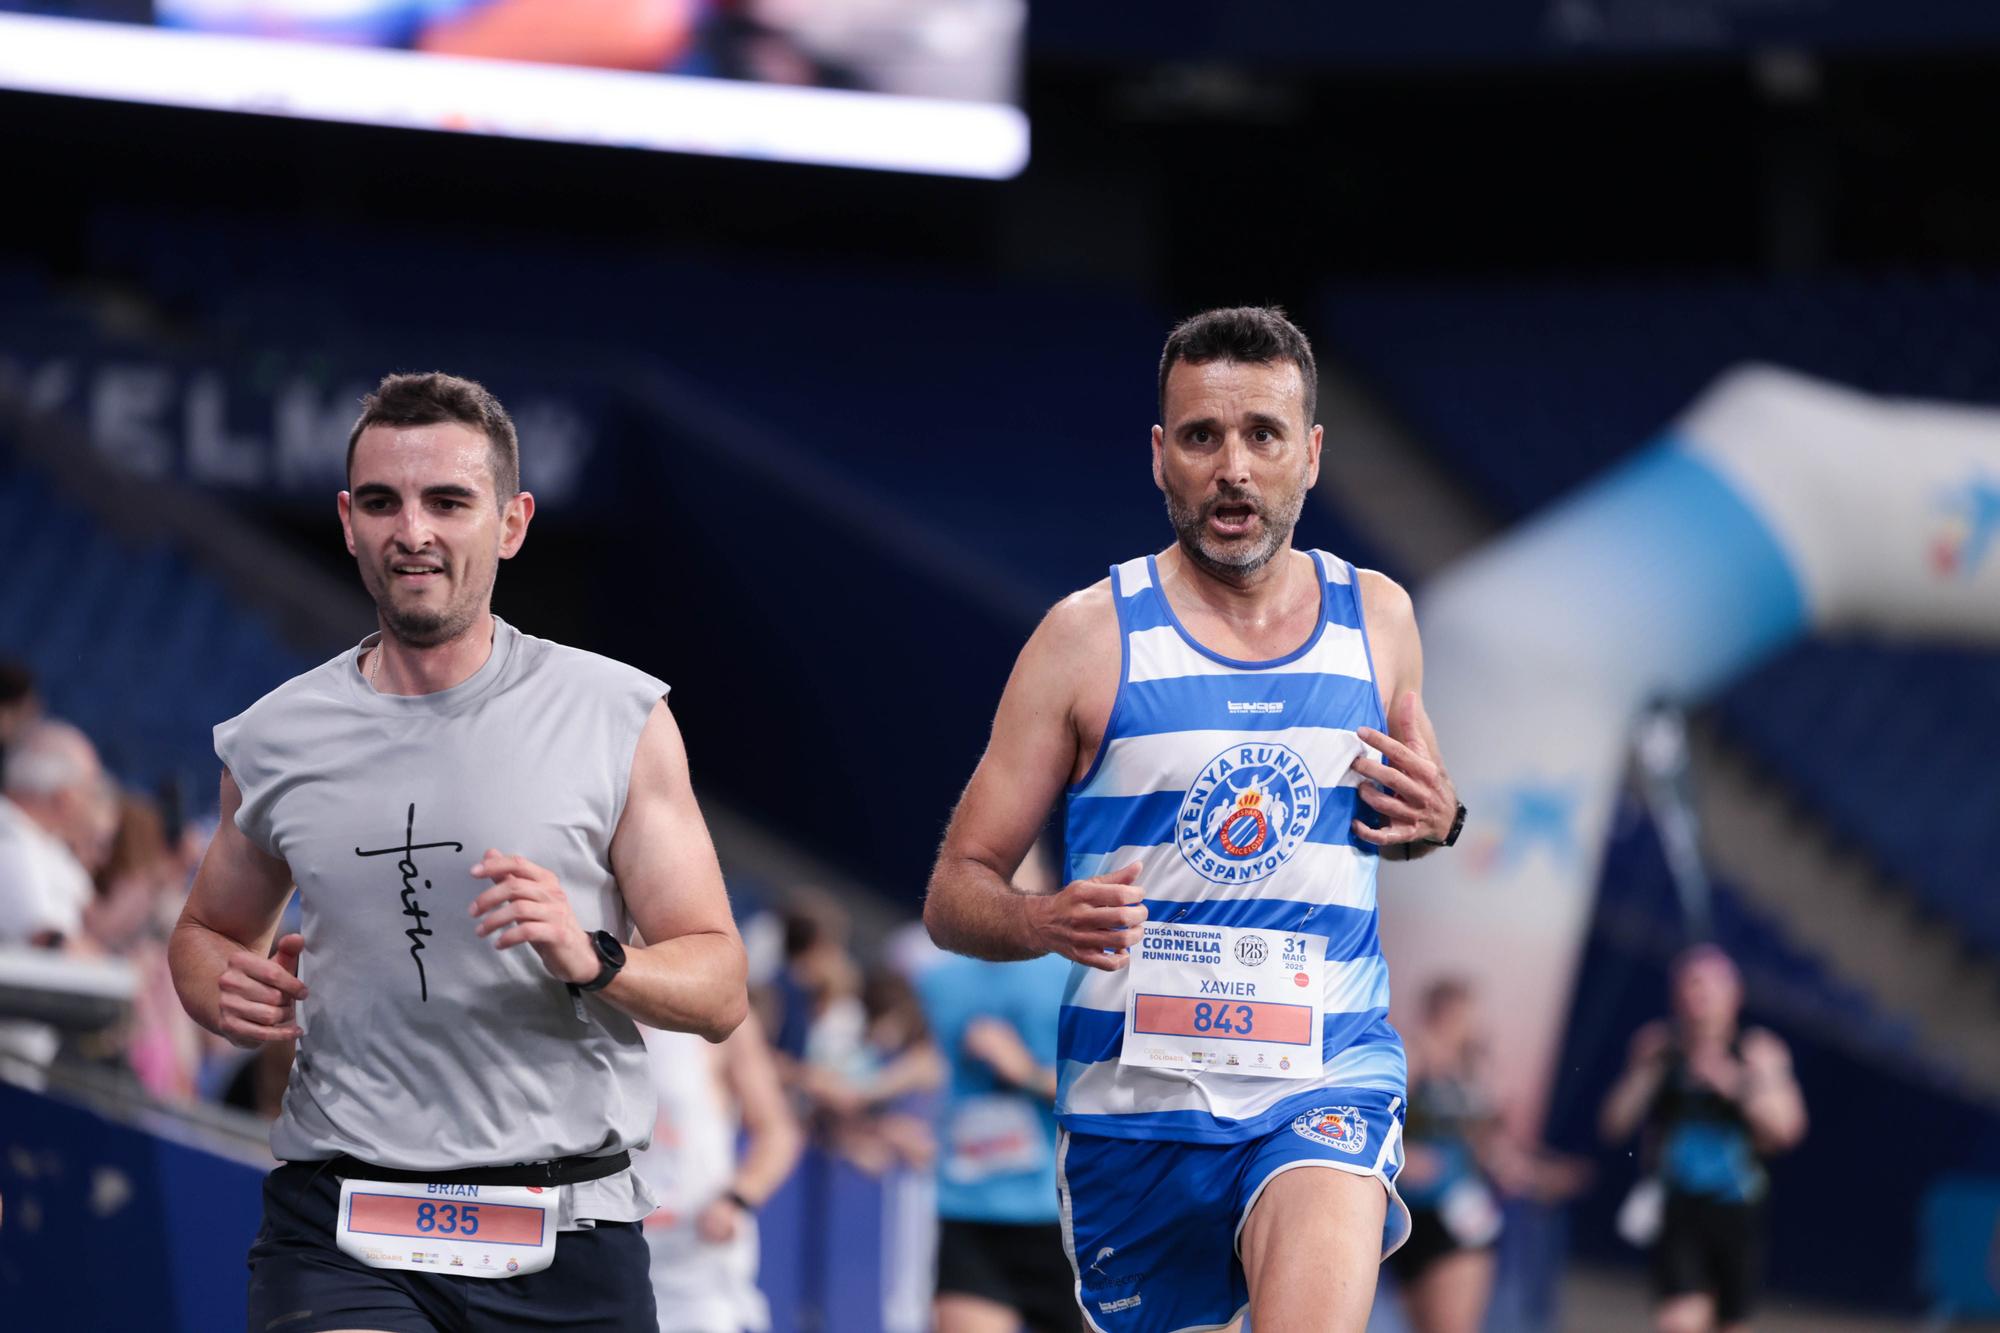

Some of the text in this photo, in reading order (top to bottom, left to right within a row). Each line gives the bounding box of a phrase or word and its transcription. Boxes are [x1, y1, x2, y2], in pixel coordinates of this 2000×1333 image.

[1183, 747, 1312, 841] PENYA RUNNERS
[1190, 848, 1288, 880] ESPANYOL
[1143, 927, 1222, 940] CURSA NOCTURNA
[1142, 937, 1221, 954] CORNELLA
[1241, 942, 1263, 959] 125
[1284, 937, 1306, 954] 31
[1142, 951, 1221, 965] RUNNING 1900
[1282, 952, 1307, 962] MAIG
[1284, 962, 1304, 971] 2025
[1199, 979, 1256, 997] XAVIER
[1193, 1002, 1254, 1035] 843
[426, 1183, 479, 1197] BRIAN
[416, 1202, 480, 1235] 835
